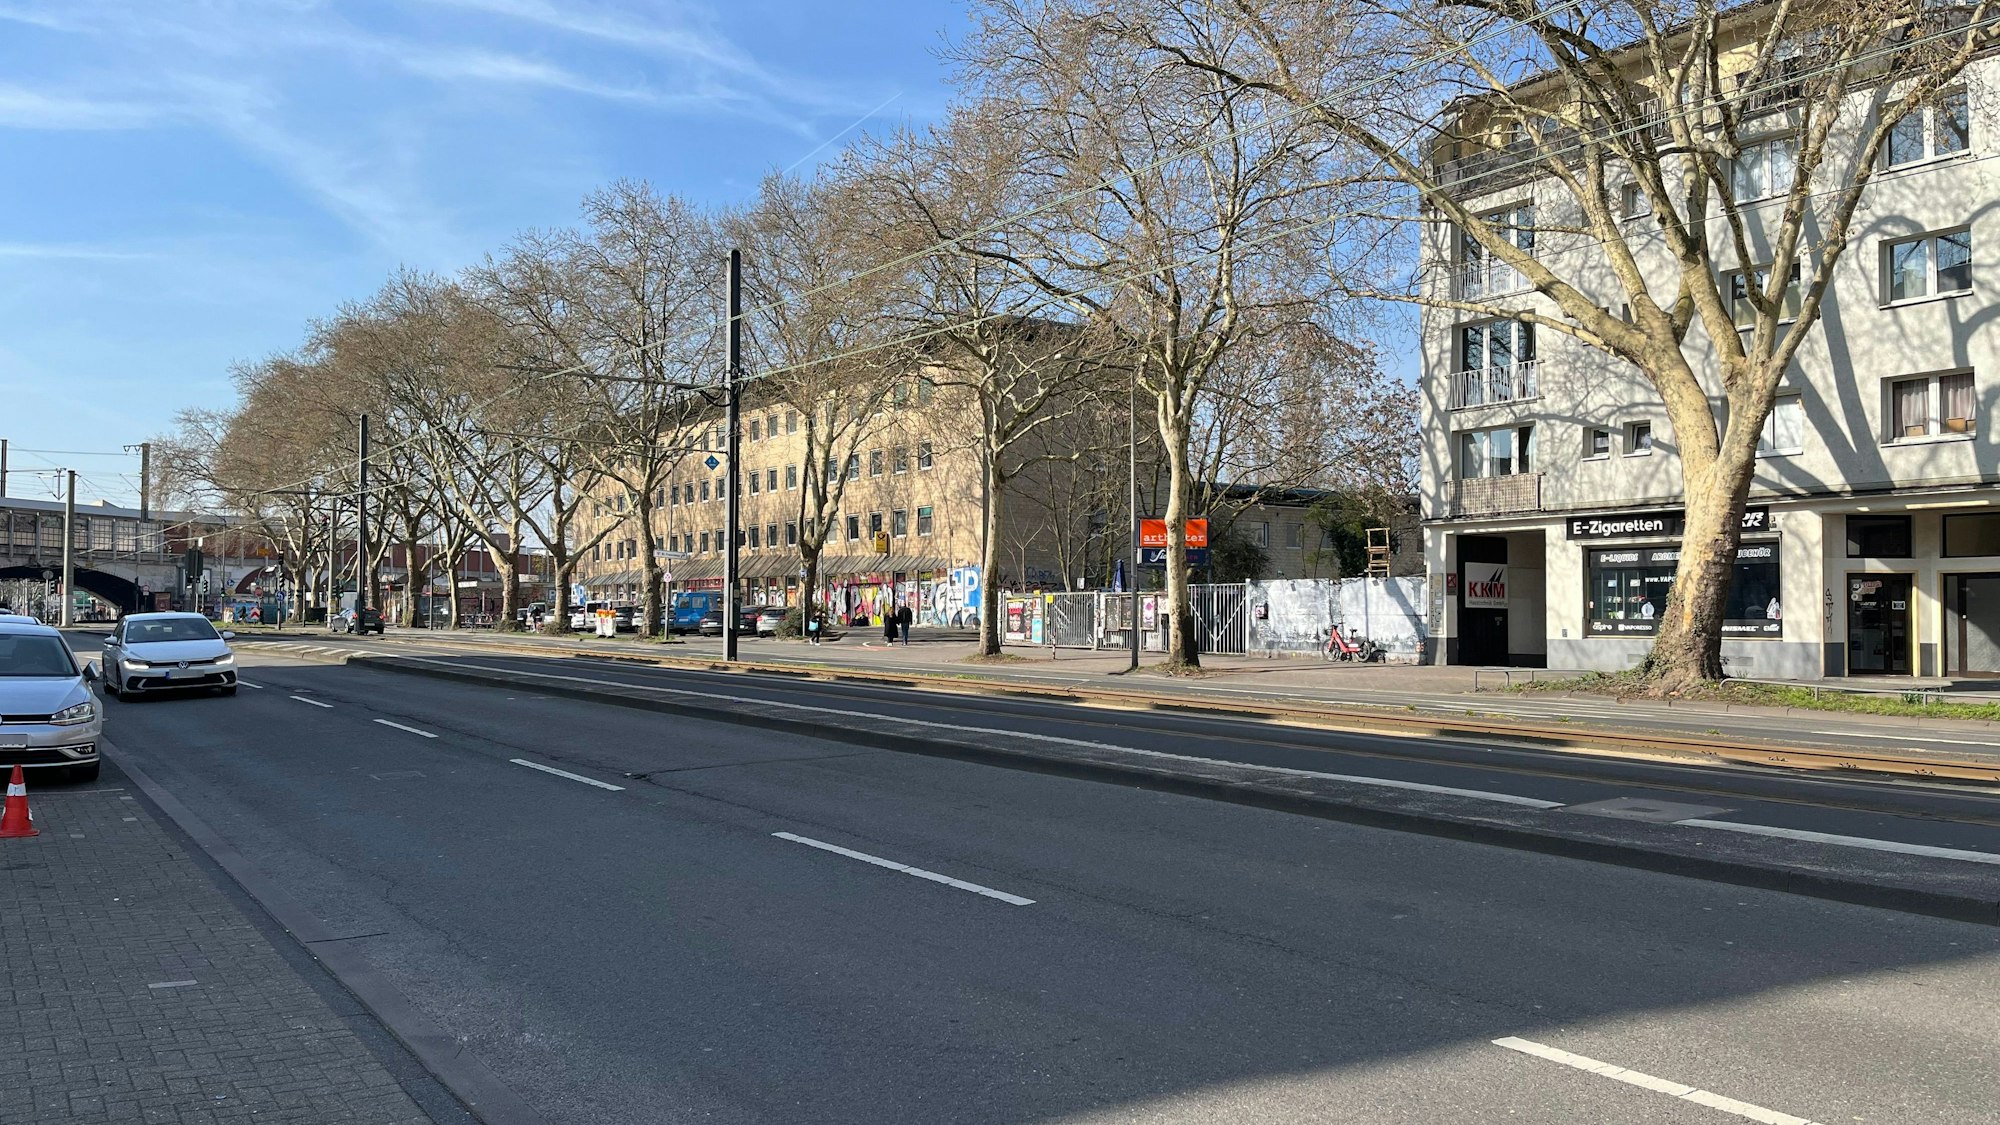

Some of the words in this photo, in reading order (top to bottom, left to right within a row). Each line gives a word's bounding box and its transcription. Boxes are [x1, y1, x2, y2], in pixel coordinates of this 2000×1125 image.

[1573, 519, 1663, 536] E-Zigaretten
[1600, 553, 1638, 563] E-LIQUIDS
[1651, 551, 1682, 561] AROME
